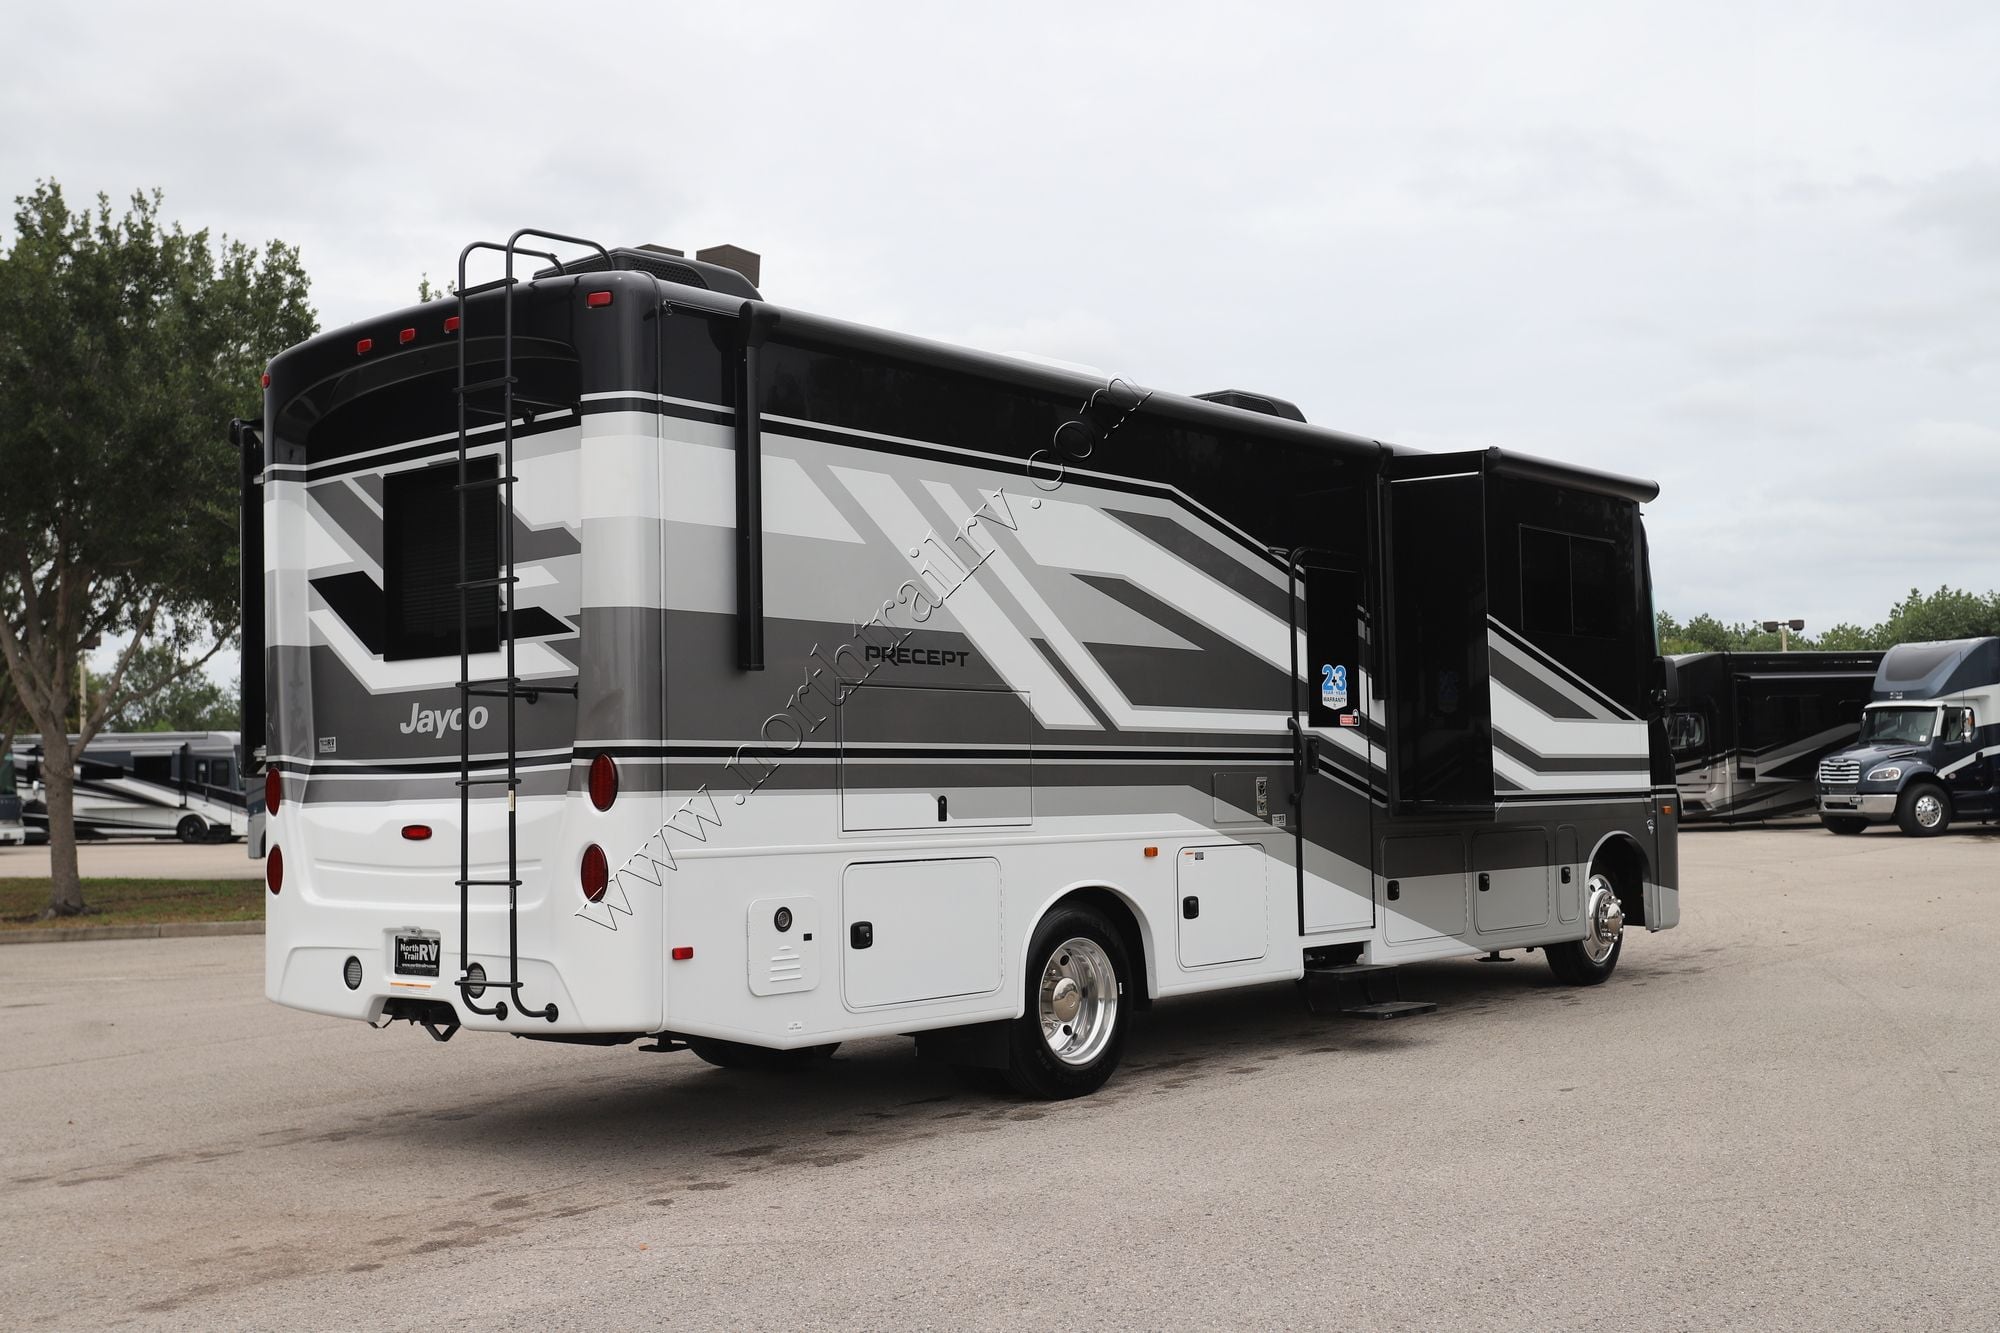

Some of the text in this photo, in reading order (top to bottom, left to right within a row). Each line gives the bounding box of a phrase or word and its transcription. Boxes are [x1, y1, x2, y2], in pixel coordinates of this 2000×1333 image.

[865, 645, 970, 667] PRECEPT
[399, 702, 489, 739] Jayco
[400, 943, 439, 961] North RV
[403, 952, 419, 961] Trail
